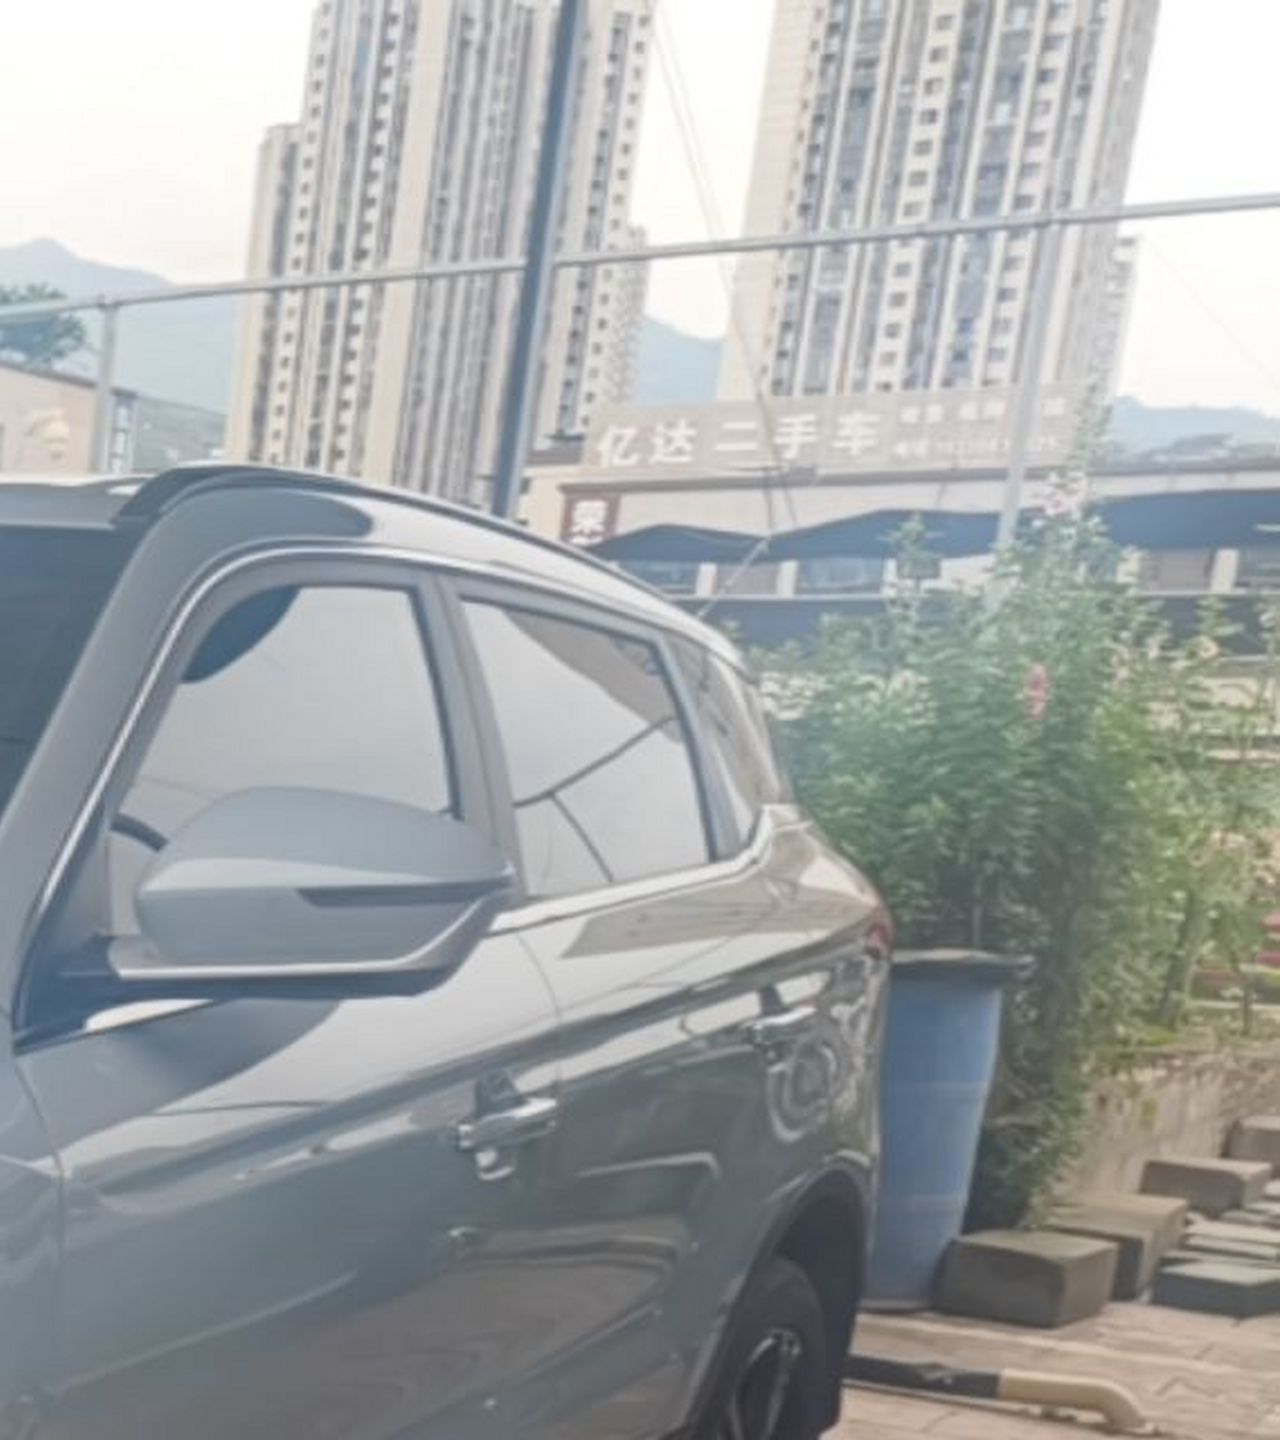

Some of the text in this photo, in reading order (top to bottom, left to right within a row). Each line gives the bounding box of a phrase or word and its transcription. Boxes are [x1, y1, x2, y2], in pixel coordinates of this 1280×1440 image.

[598, 411, 881, 467] 亿达二手车
